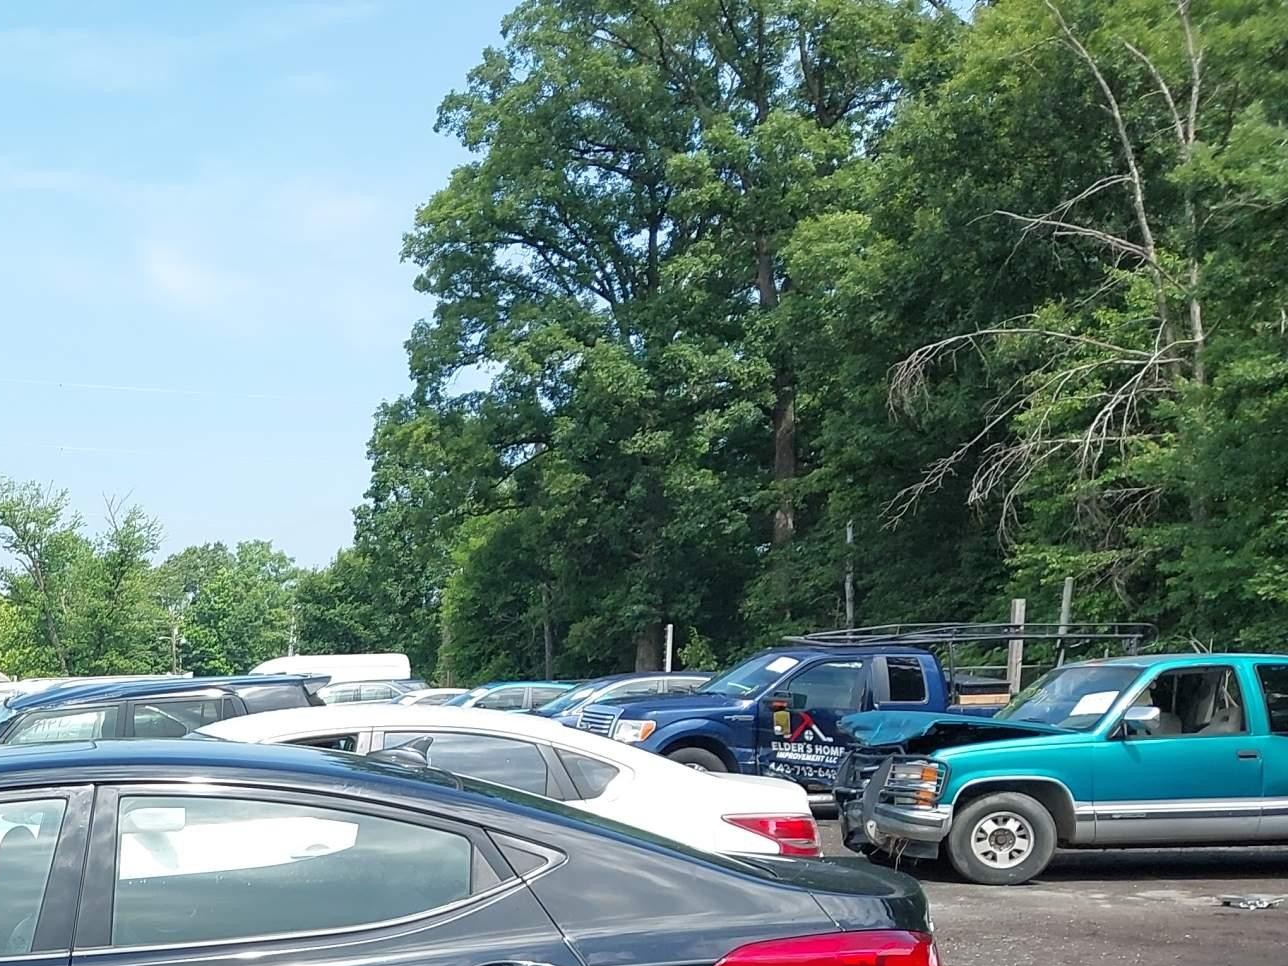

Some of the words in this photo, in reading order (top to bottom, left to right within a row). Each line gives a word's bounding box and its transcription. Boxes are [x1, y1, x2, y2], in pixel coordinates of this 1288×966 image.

[771, 741, 813, 754] ELDER'S
[776, 751, 825, 763] IMPROVEMENT
[825, 756, 839, 764] LLC
